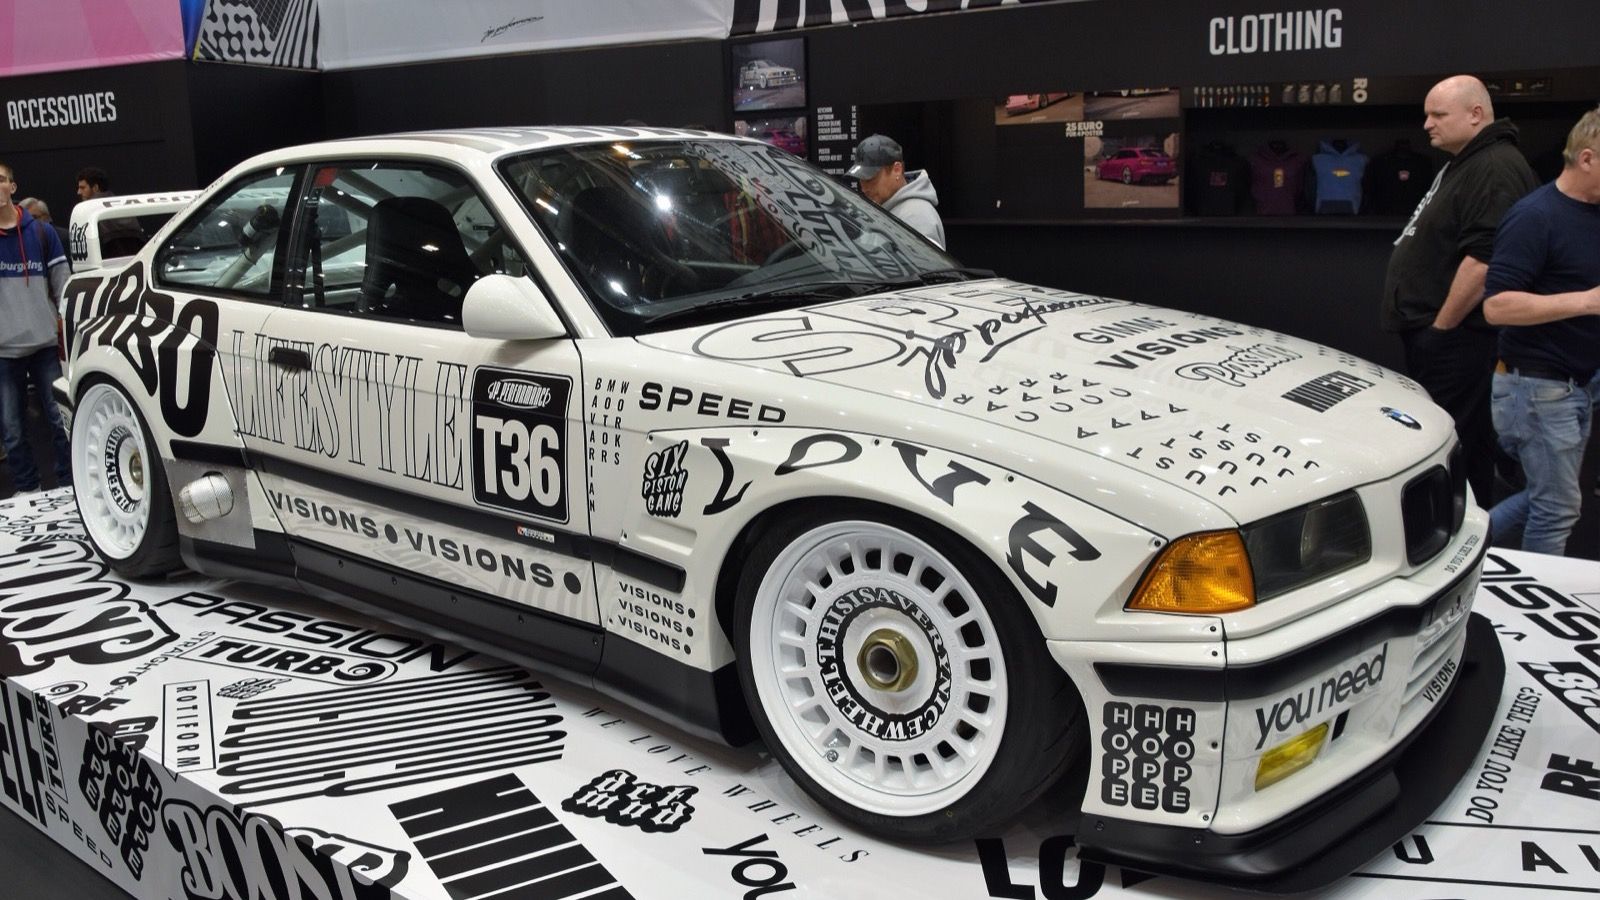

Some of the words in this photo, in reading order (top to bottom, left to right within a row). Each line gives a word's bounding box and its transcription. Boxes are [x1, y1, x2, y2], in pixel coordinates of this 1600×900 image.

[1209, 8, 1343, 56] CLOTHING
[7, 91, 118, 131] ACCESSOIRES
[1077, 120, 1104, 130] EURO
[63, 260, 219, 438] TURBO
[1094, 326, 1245, 370] VISIONS
[232, 329, 468, 491] LIFESTYLE
[639, 381, 787, 424] SPEED
[476, 416, 562, 508] T36
[645, 440, 688, 480] SIX
[643, 470, 685, 496] PISTON
[647, 494, 681, 513] GANG
[268, 489, 380, 539] VISIONS
[404, 527, 555, 592] VISIONS
[700, 433, 1102, 608] LOVE
[618, 580, 686, 616] VISIONS
[618, 598, 684, 634] VISIONS
[154, 591, 480, 673] PASSION
[617, 614, 682, 652] VISIONS
[200, 640, 387, 682] TURBO
[1422, 658, 1457, 703] VISIONS
[1254, 687, 1315, 750] you
[1316, 642, 1389, 714] need
[1507, 686, 1543, 724] THIS?
[176, 685, 202, 768] ROTIFORM
[1493, 724, 1527, 761] LIKE
[582, 706, 627, 729] WE
[629, 734, 713, 777] LOVE
[721, 783, 870, 864] WHEELS
[1476, 750, 1512, 794] YOU
[45, 792, 112, 869] SPEED
[1465, 796, 1499, 824] DO
